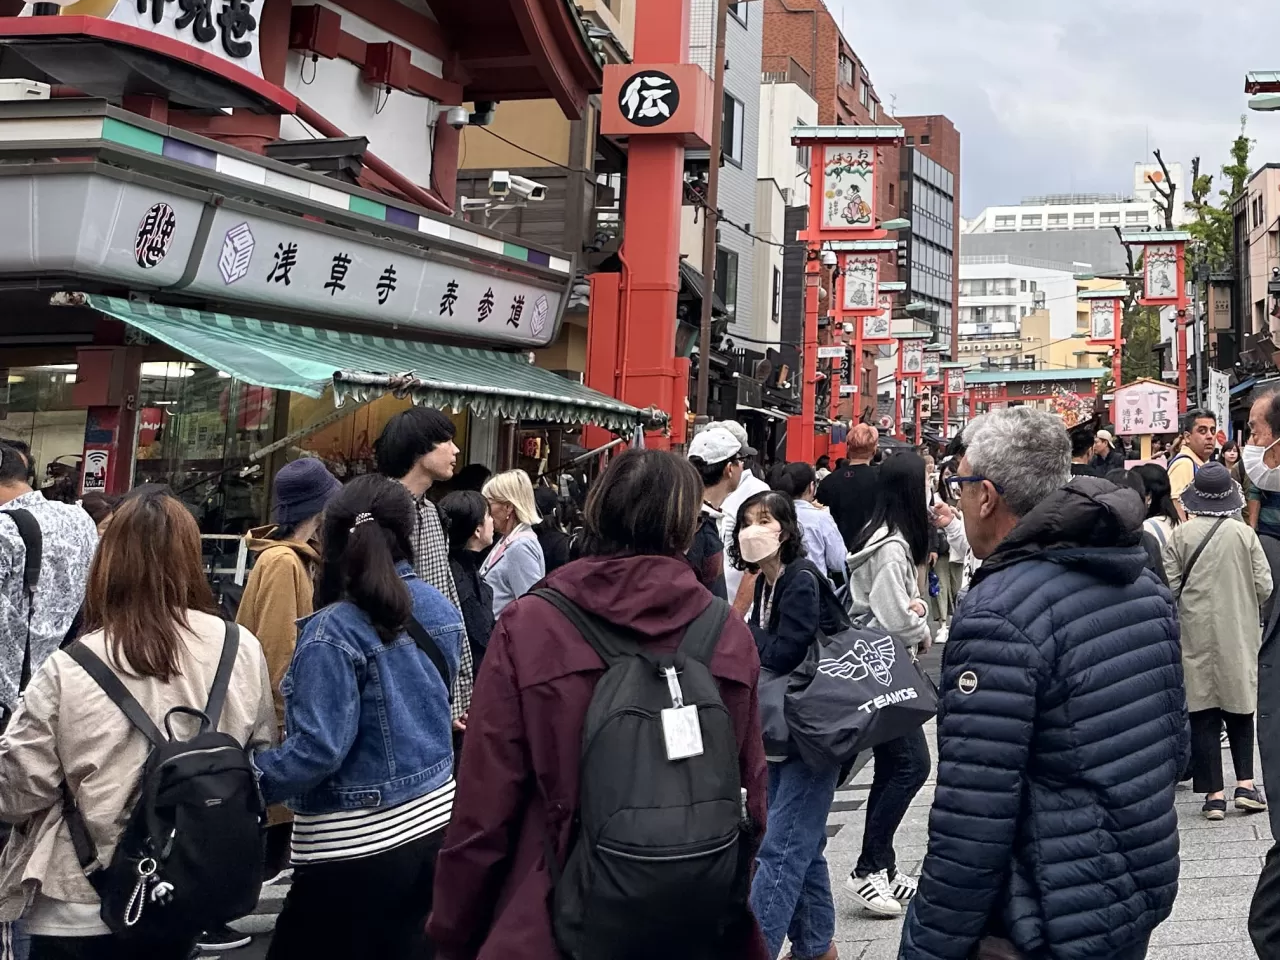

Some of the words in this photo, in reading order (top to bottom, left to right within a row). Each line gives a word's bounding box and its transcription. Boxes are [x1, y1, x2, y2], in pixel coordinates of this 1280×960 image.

[266, 242, 398, 305] 浅草寺
[439, 279, 525, 328] 表参道
[1122, 408, 1132, 431] 通行止
[1148, 390, 1171, 430] 下馬
